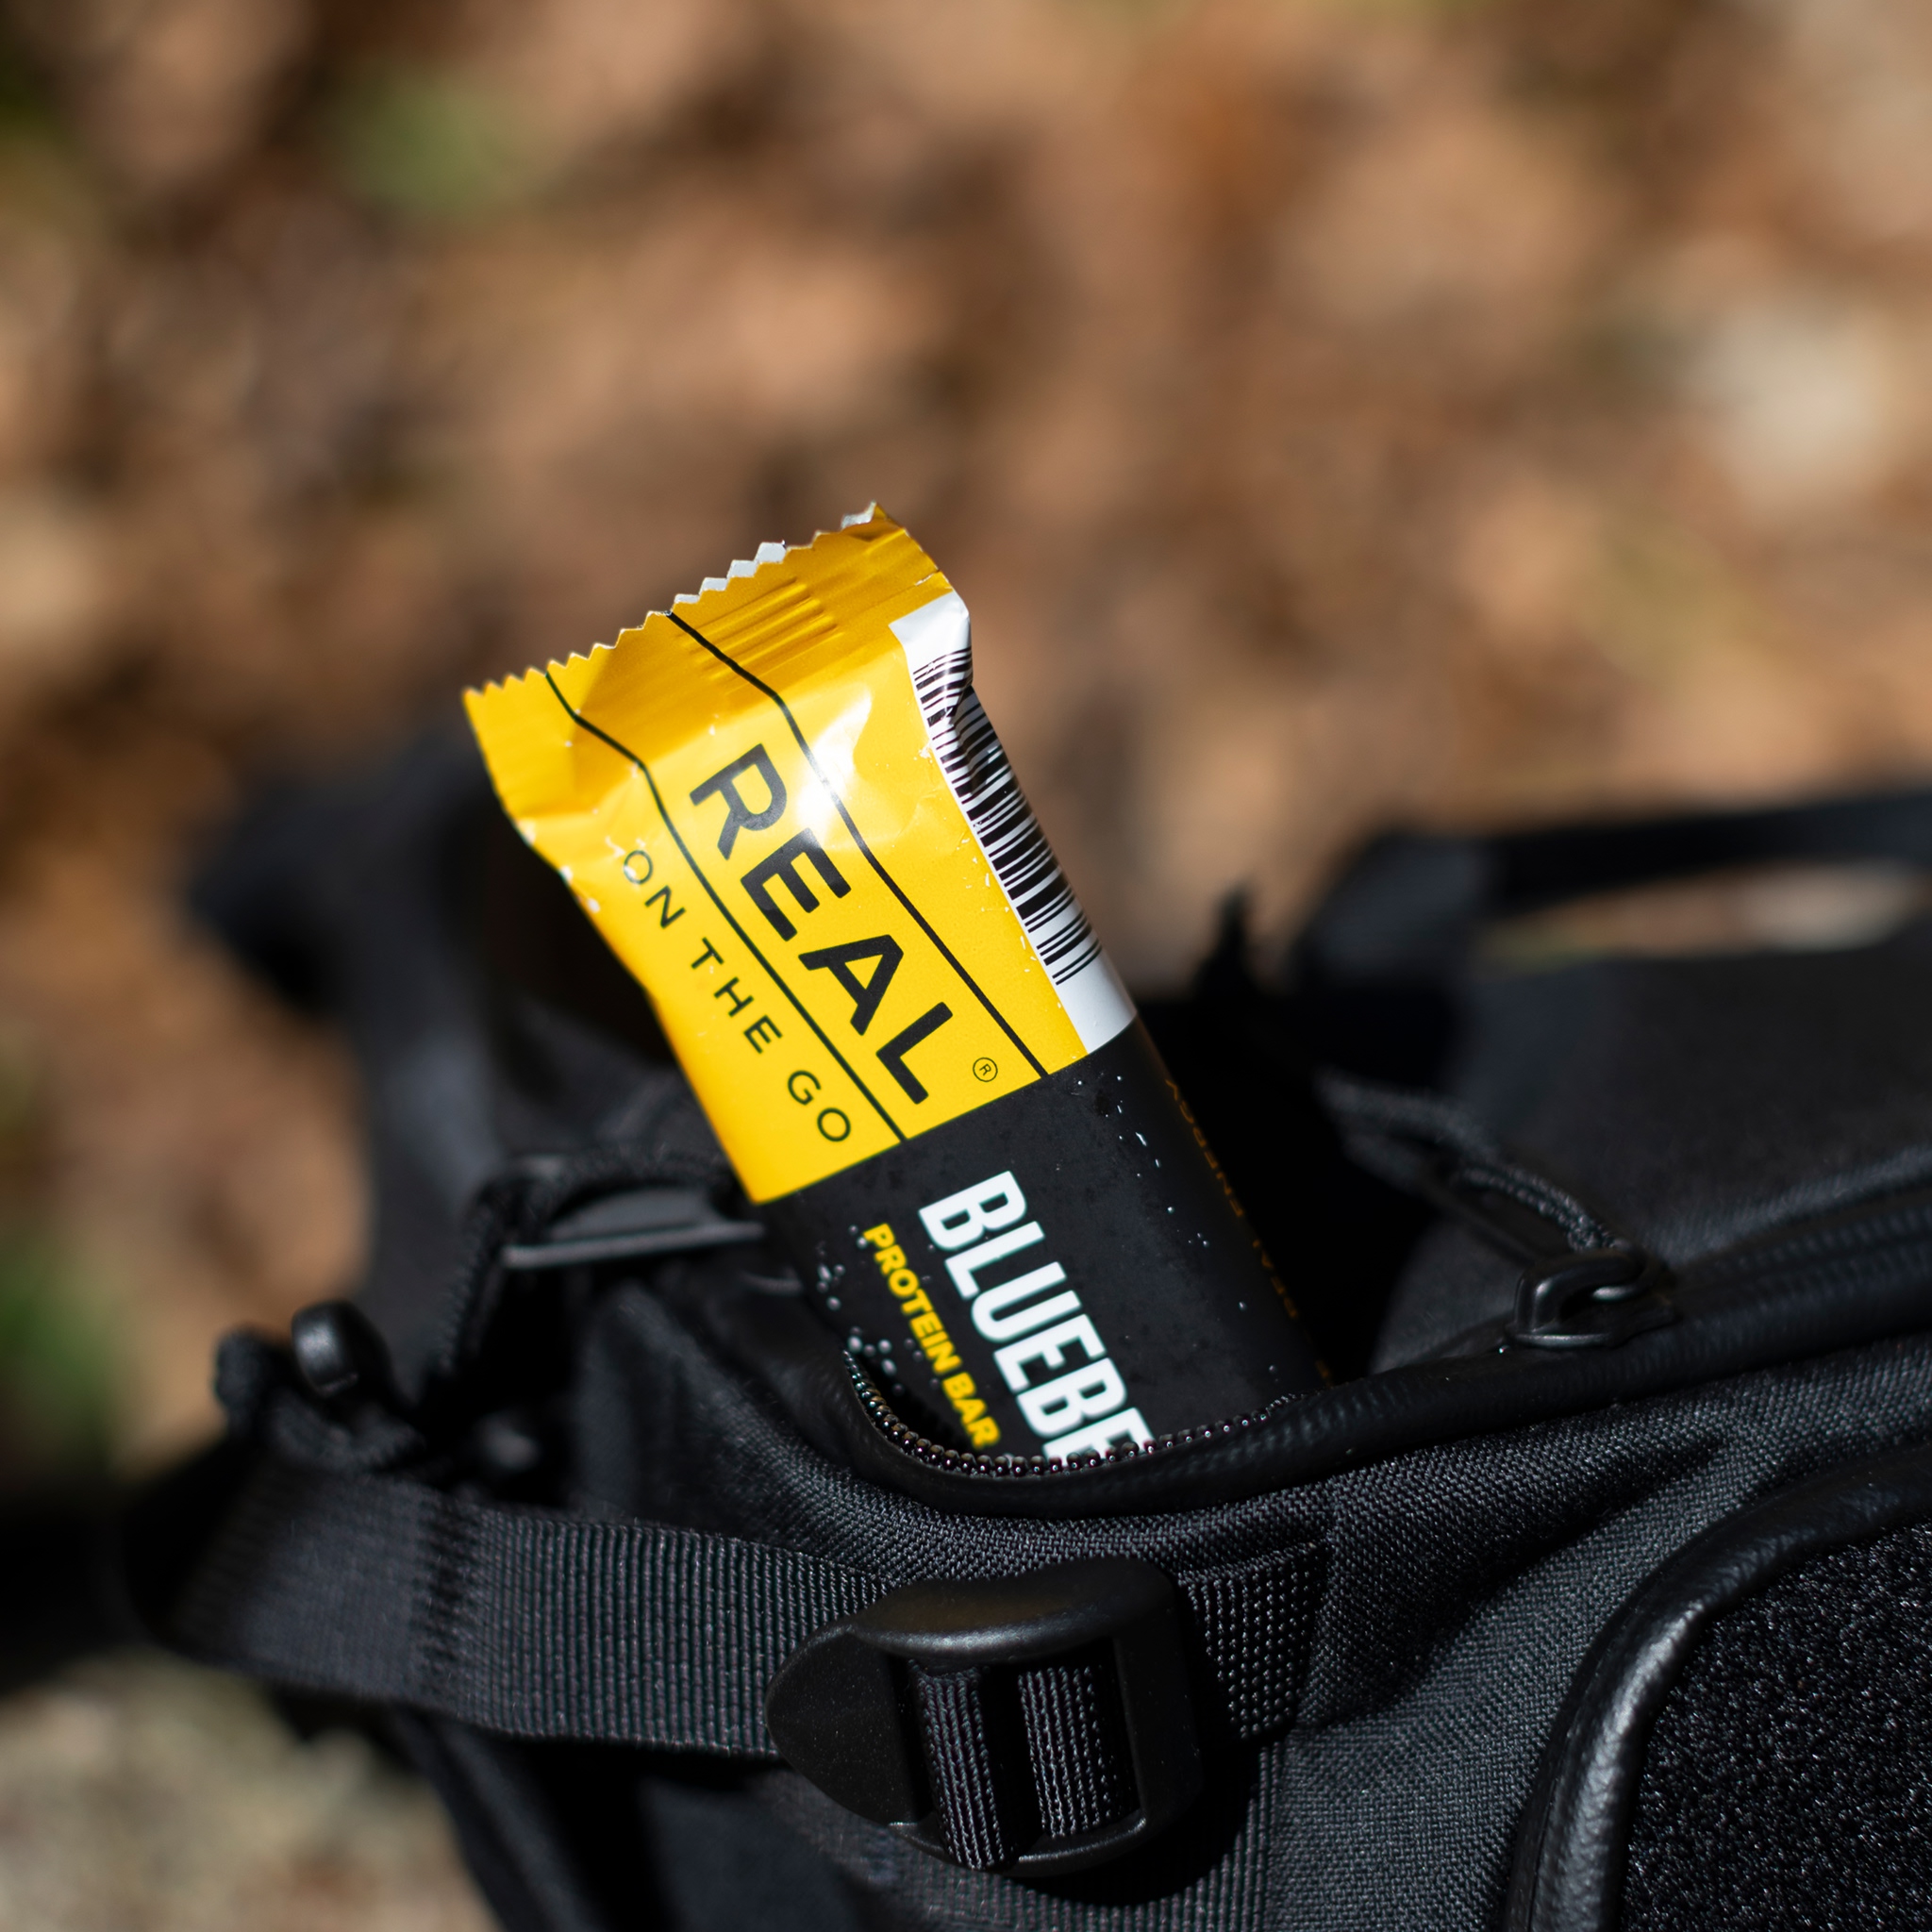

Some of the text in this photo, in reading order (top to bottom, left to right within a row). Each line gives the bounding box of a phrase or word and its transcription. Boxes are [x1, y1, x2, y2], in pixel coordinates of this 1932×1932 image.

[623, 849, 852, 1143] ON THE GO
[691, 743, 954, 1105] REAL
[862, 1223, 1001, 1450] PROTEIN BAR
